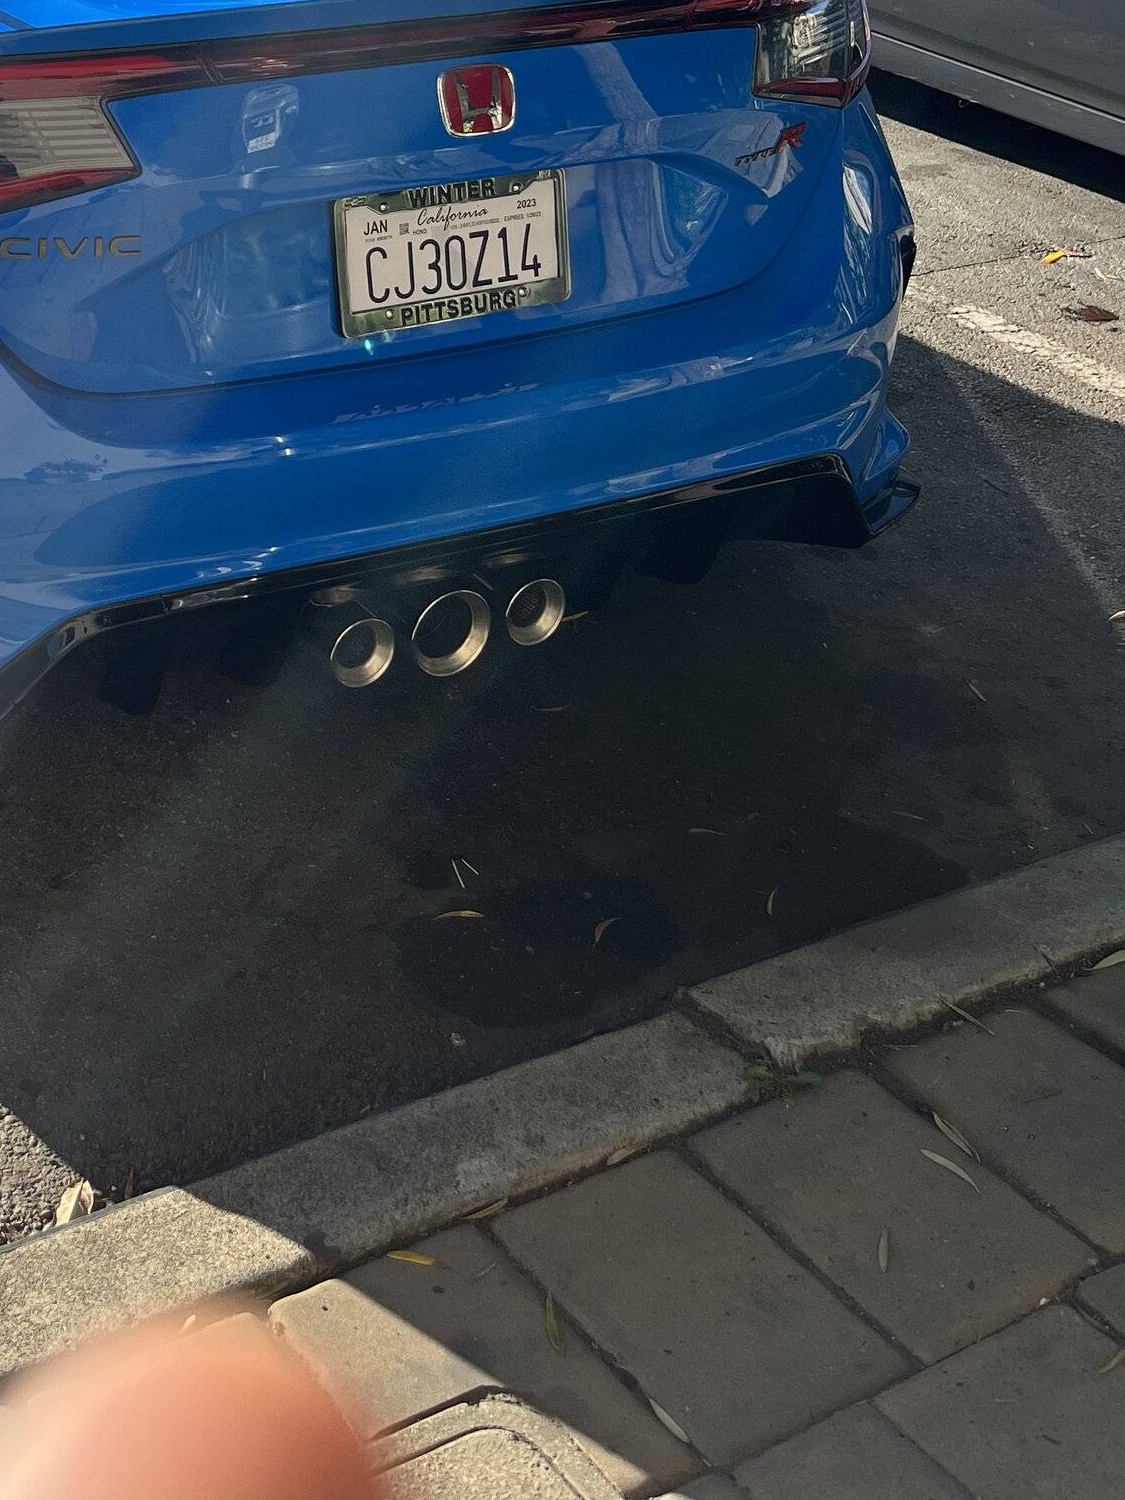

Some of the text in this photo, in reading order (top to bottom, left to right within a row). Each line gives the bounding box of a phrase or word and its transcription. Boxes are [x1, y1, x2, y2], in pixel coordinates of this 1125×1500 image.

[407, 178, 496, 208] WINTER
[516, 198, 536, 209] 2023
[363, 219, 388, 236] JAN
[417, 205, 488, 231] California
[365, 223, 542, 304] CJ30Z14
[400, 288, 516, 326] PITTSBURG
